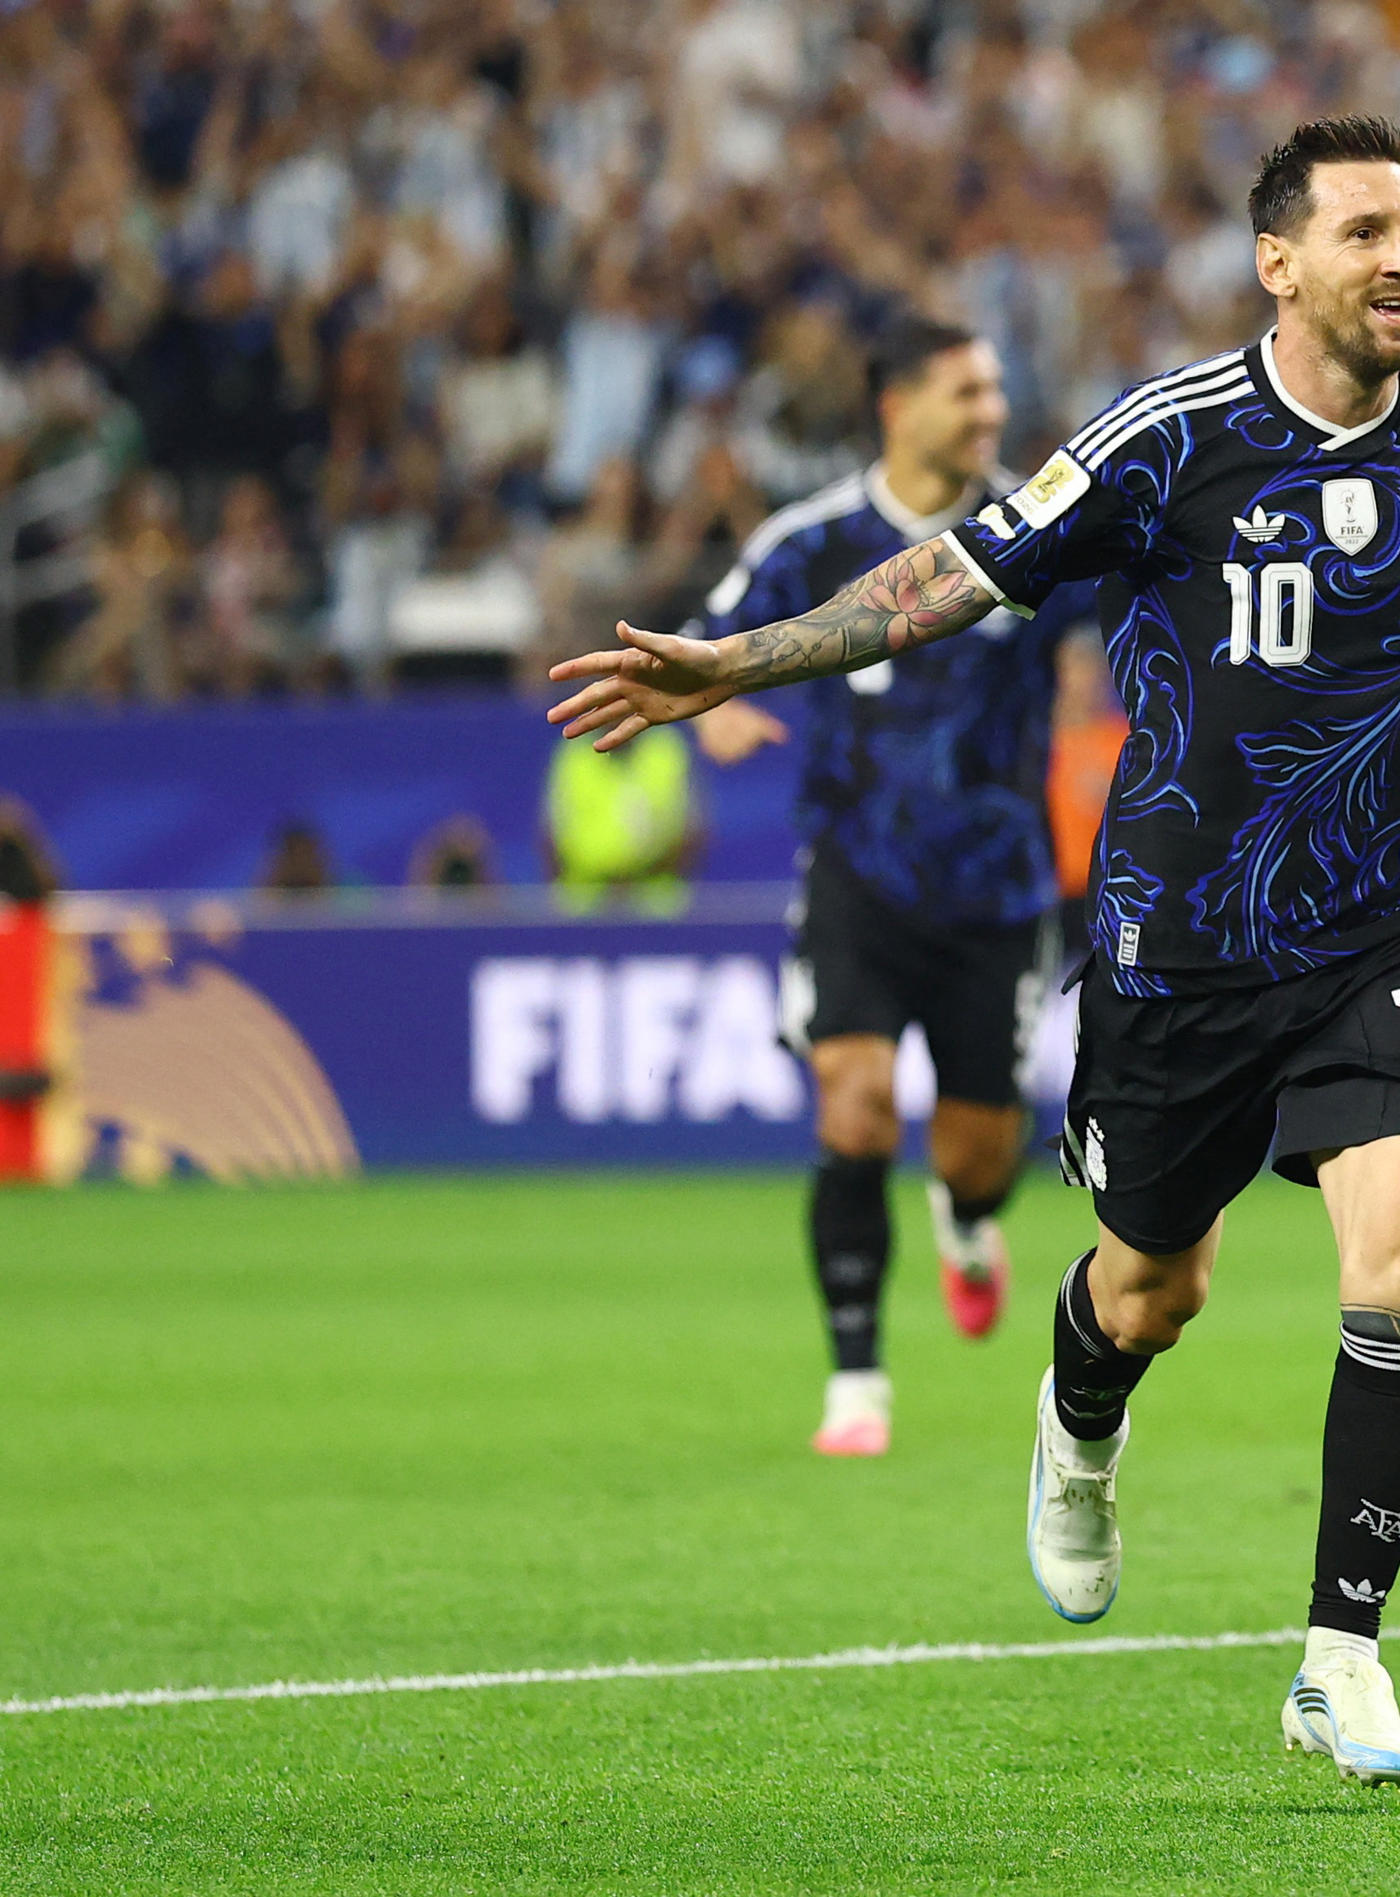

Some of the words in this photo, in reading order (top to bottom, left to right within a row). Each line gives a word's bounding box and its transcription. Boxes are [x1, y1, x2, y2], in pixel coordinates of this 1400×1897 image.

[1340, 526, 1363, 535] FIFA
[1222, 562, 1314, 667] 10
[472, 956, 800, 1122] FIFA
